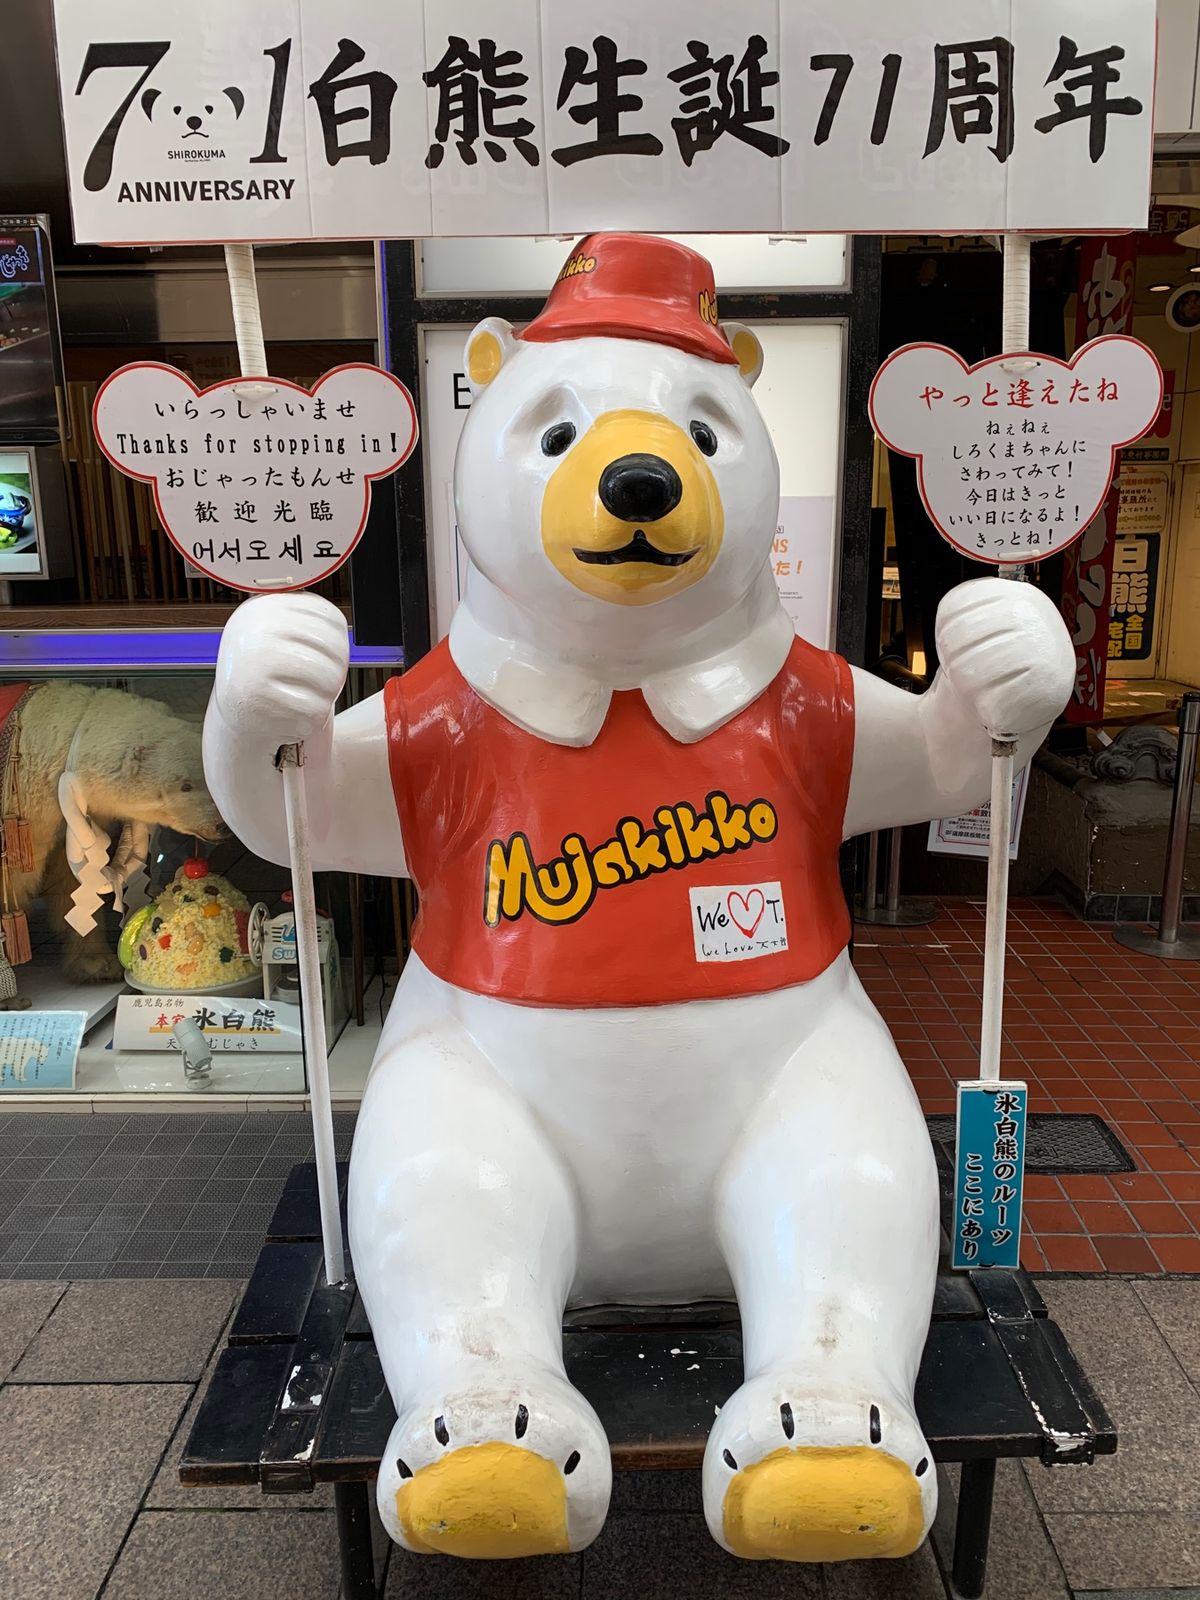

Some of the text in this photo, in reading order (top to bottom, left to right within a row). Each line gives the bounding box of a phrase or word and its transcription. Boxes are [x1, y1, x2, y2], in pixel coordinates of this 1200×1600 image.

[167, 149, 226, 160] SHIROKUMA
[117, 178, 295, 203] ANNIVERSARY
[919, 377, 1120, 411] やっと逢えたね
[155, 399, 357, 420] いらっしゃいませ
[985, 418, 1051, 436] ねぇねぇ
[116, 432, 398, 456] Thanks for stopping in!
[952, 439, 1087, 460] しろくまちゃんに
[165, 466, 356, 489] おじゃったもんせ
[959, 460, 1074, 483] さわってみて！
[965, 484, 1066, 507] 今日はきっと
[194, 499, 334, 524] 歓迎光臨
[949, 504, 1081, 527] いい日になるよ！
[192, 533, 342, 565] 어서오세요
[975, 528, 1053, 549] きっとね！
[696, 902, 730, 932] We
[132, 998, 184, 1008] 鹿児島名物
[192, 1008, 276, 1031] 氷白熊
[993, 1092, 1023, 1246] 氷白熊のルーツ
[961, 1152, 985, 1260] ここにあり
